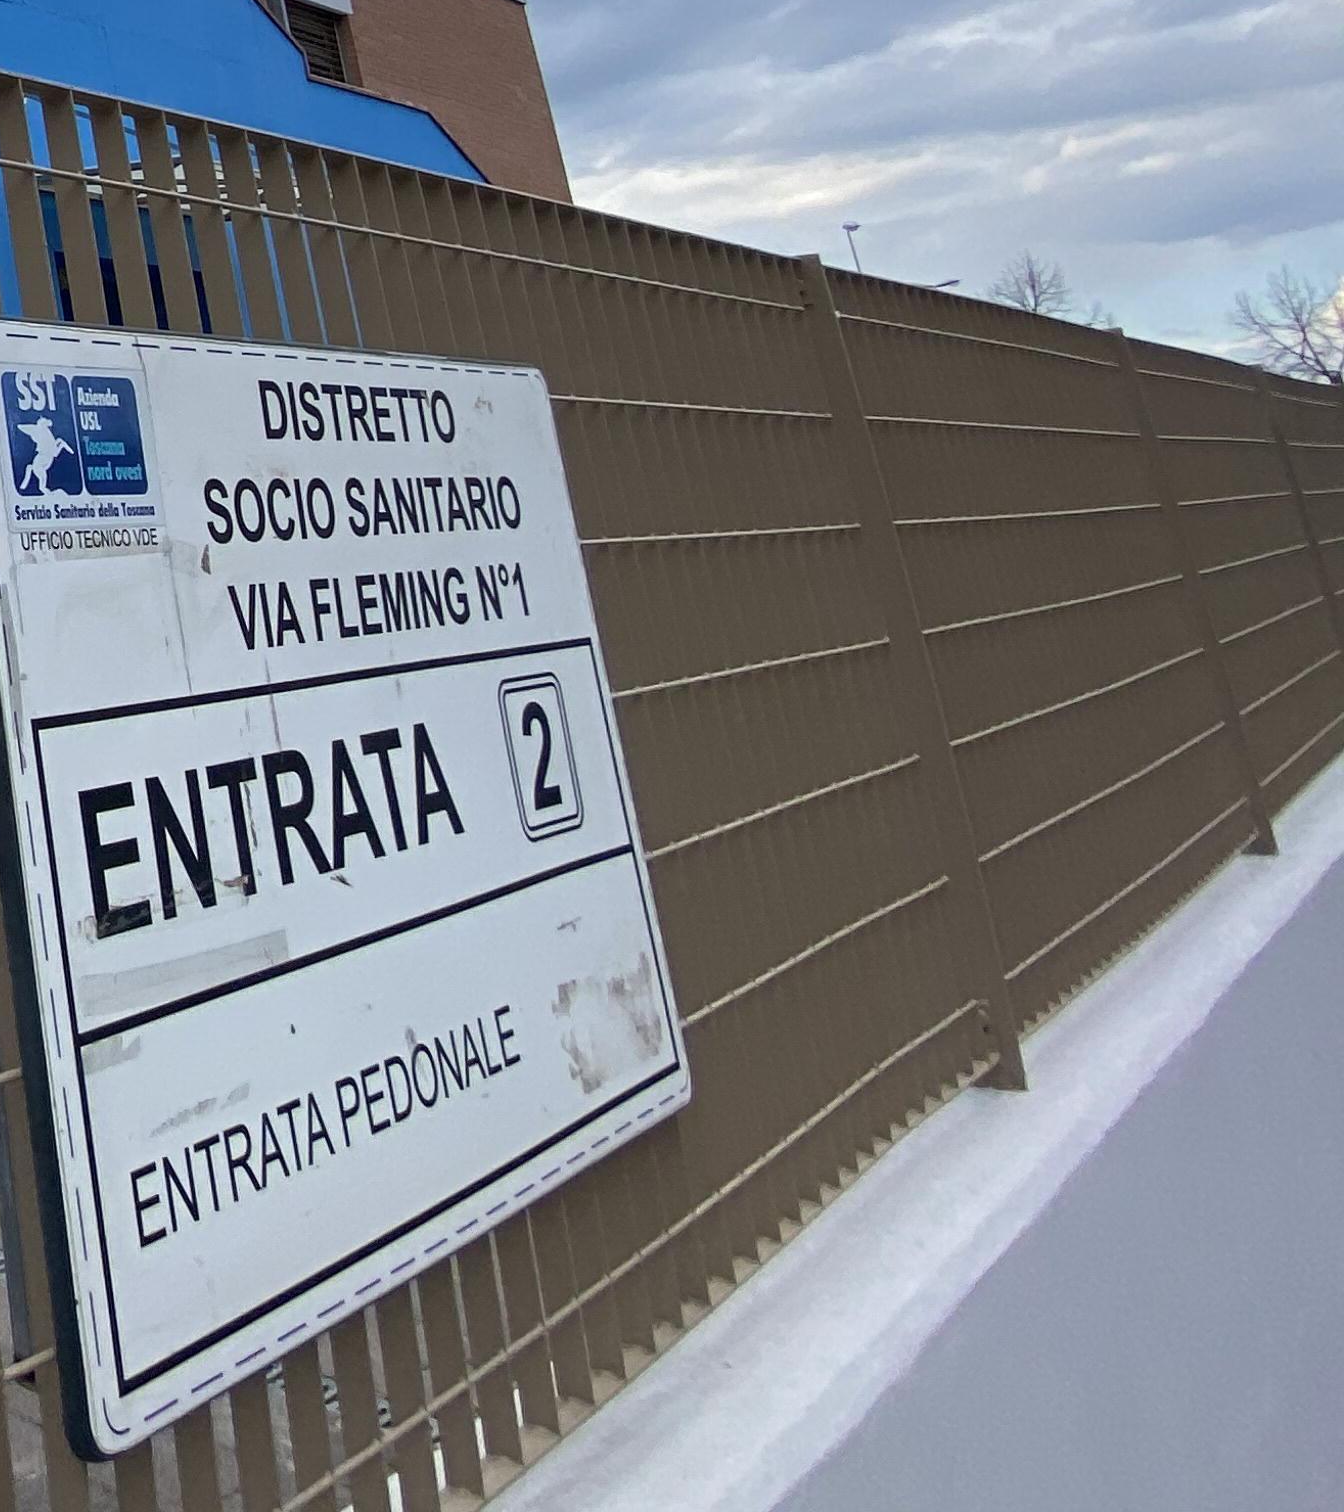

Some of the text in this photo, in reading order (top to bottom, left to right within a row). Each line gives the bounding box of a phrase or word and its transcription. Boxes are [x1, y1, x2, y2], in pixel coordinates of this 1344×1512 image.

[15, 372, 56, 411] SST
[77, 387, 119, 406] Azienda
[257, 379, 456, 443] DISTRETTO
[79, 411, 101, 431] USL
[83, 436, 125, 456] Toscana
[87, 461, 143, 481] nord ovest
[14, 501, 155, 521] Servizio Sanitario della Toscana
[204, 475, 522, 544] SOCIO SANITARIO
[20, 528, 159, 551] UFFICIO TECNICO VDE
[228, 581, 306, 650] VIA
[310, 567, 470, 641] FLEMING
[521, 700, 564, 811] 2
[78, 722, 464, 940] ENTRATA
[129, 1005, 522, 1248] ENTRATA PEDONALE
